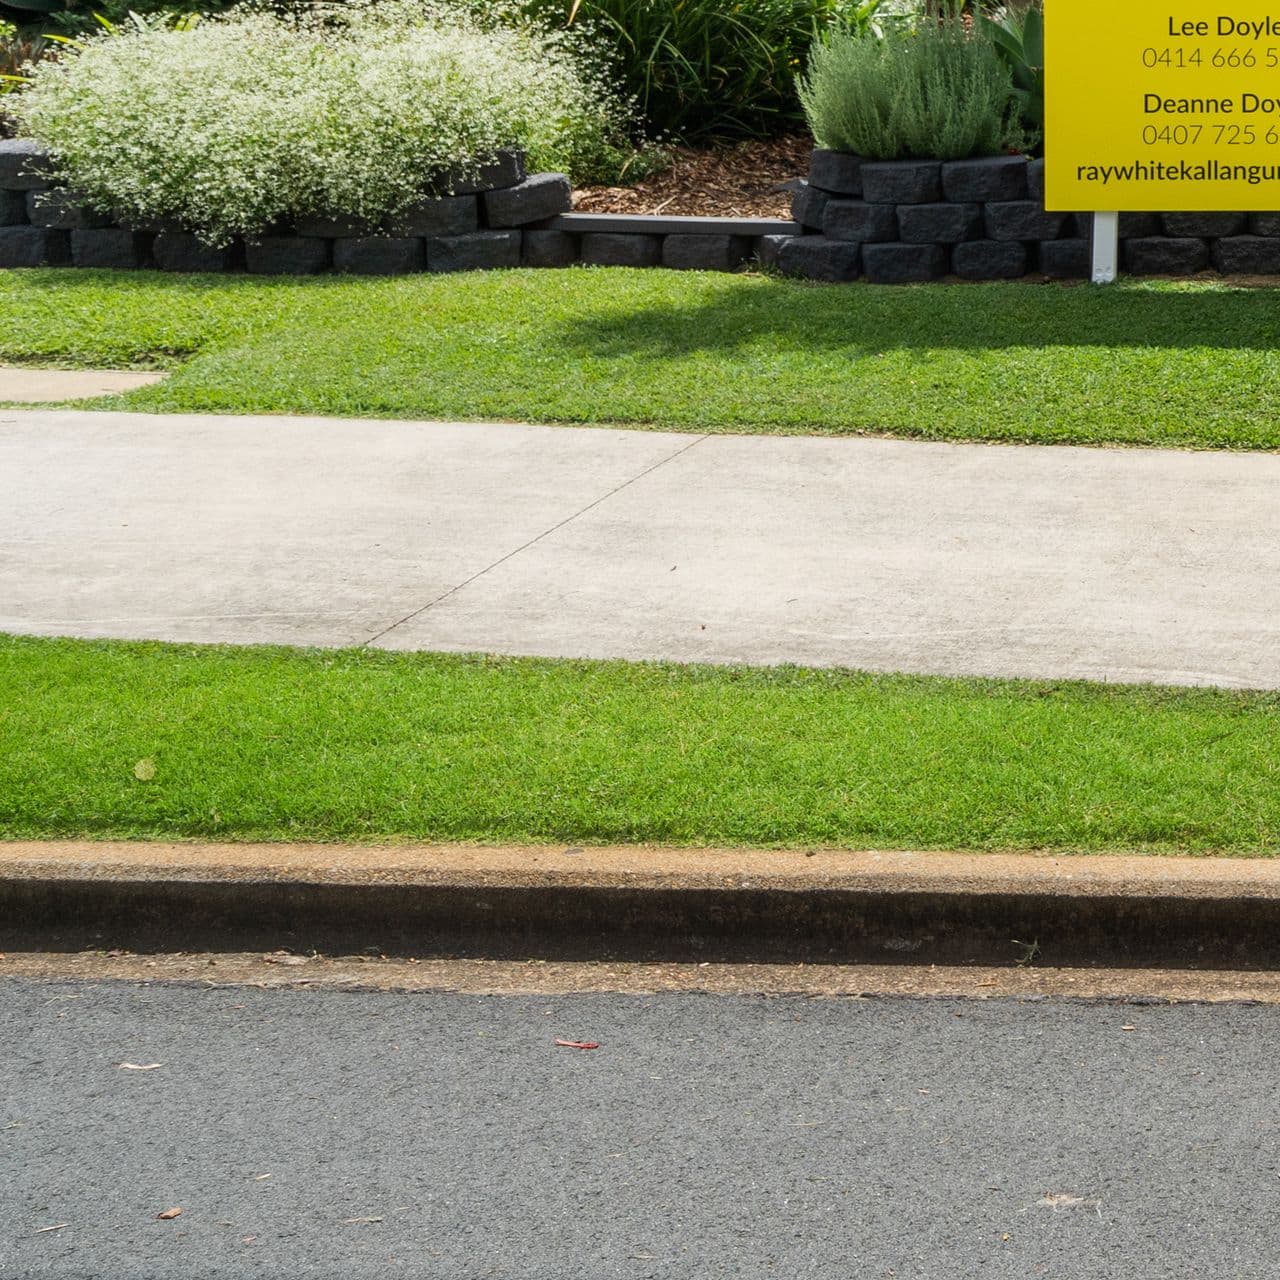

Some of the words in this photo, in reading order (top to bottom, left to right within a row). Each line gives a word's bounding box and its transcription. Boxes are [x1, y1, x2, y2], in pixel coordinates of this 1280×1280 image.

[1168, 15, 1209, 37] Lee
[1142, 47, 1203, 68] 0414
[1211, 47, 1257, 68] 666
[1143, 93, 1234, 114] Deanne
[1142, 124, 1203, 146] 0407
[1212, 124, 1257, 145] 725
